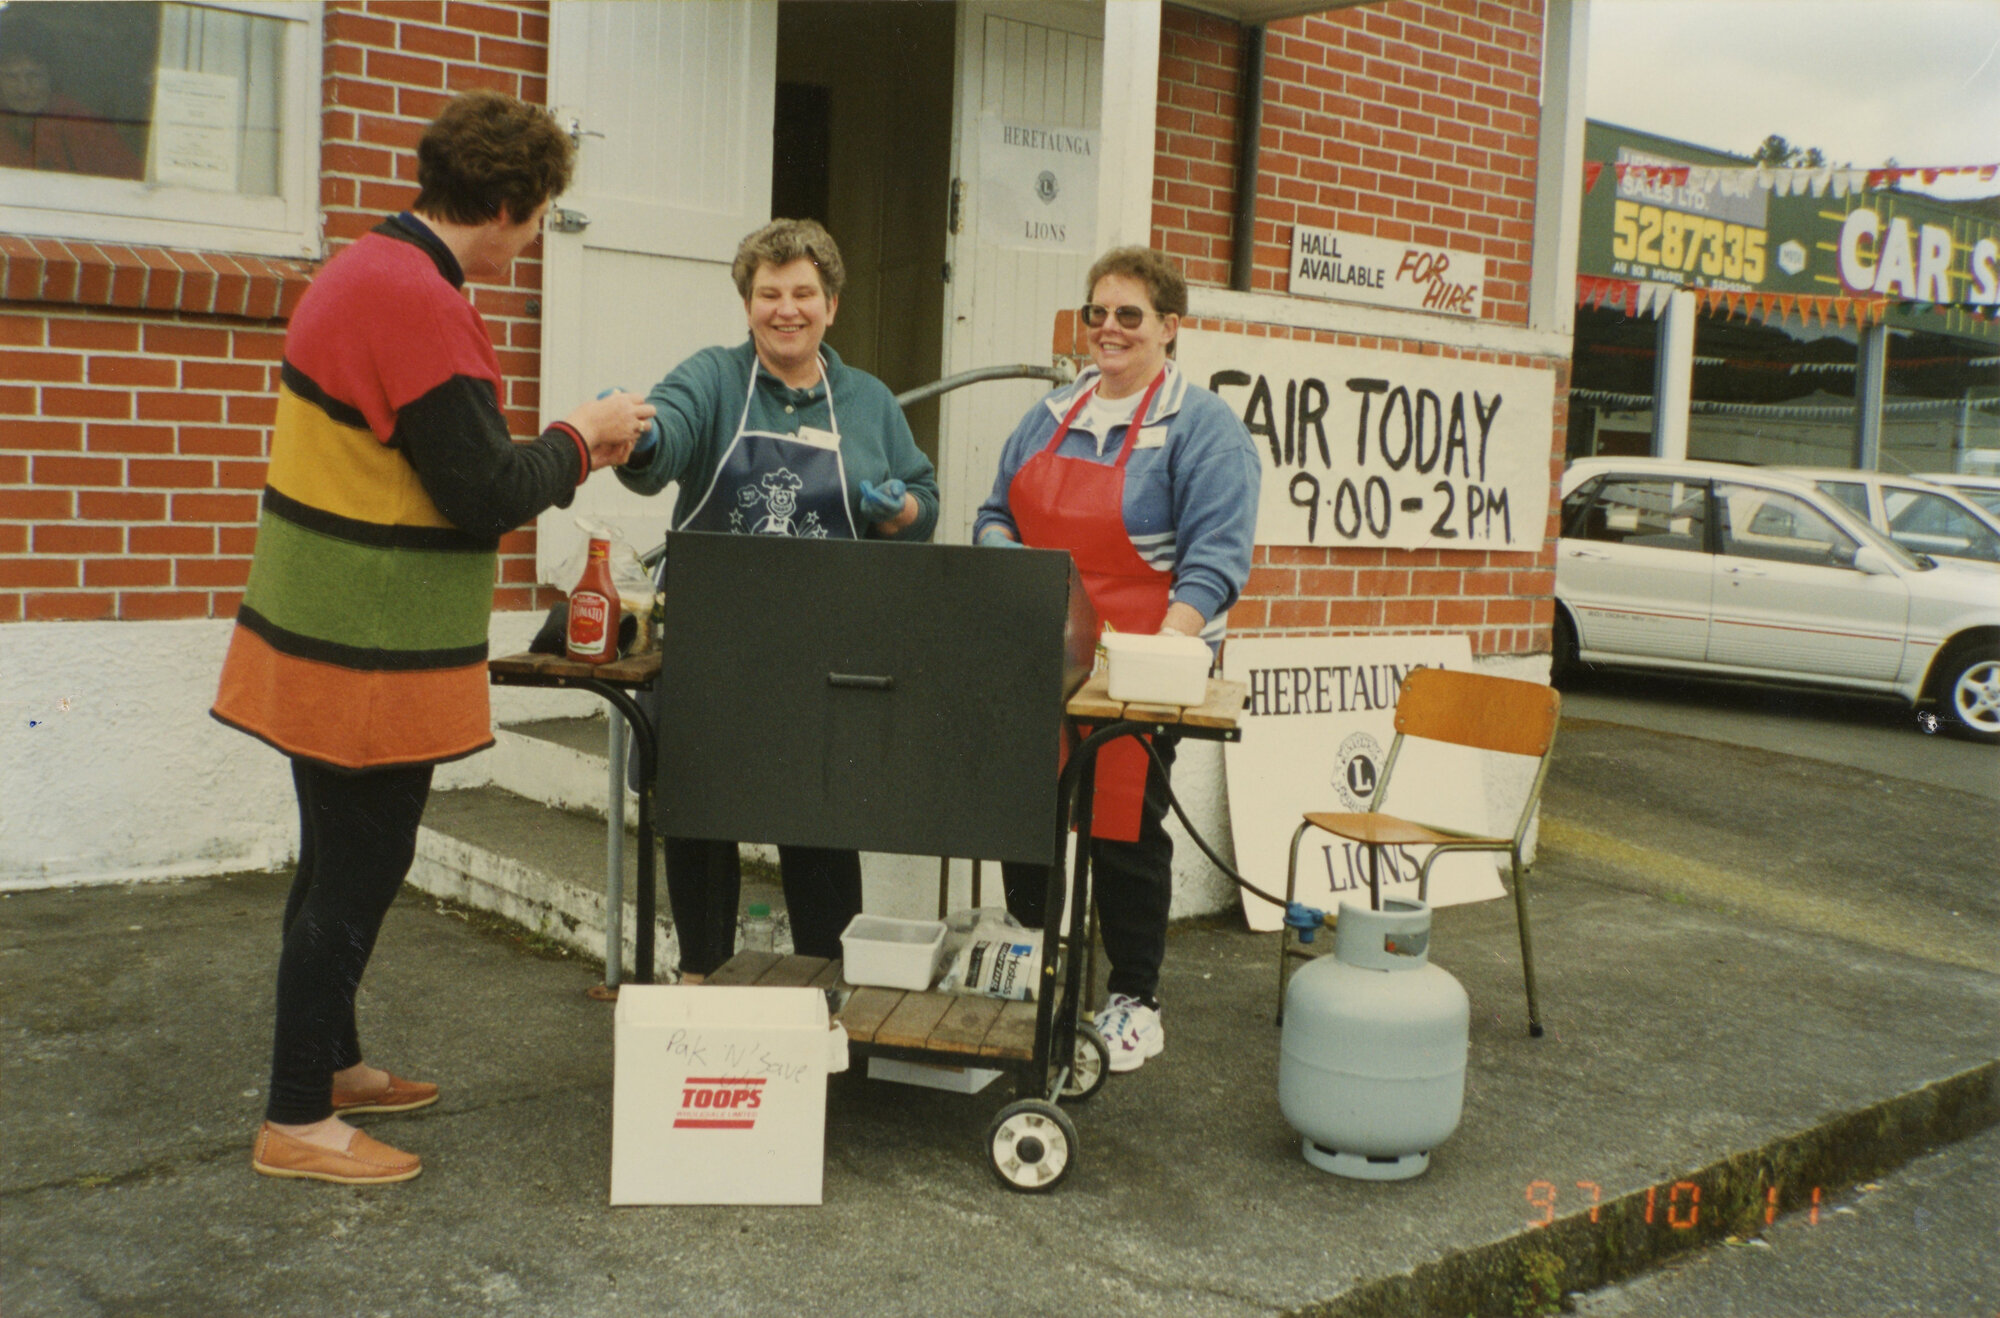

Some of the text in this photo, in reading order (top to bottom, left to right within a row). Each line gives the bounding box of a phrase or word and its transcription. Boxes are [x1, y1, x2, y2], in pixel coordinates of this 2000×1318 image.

[1003, 125, 1091, 156] HERETAUNGA
[1025, 220, 1066, 242] LIONS
[1300, 232, 1342, 259] HALL
[1612, 200, 1767, 284] 5287335
[1298, 257, 1385, 289] AVAILABLE
[1395, 249, 1450, 284] FOR
[1839, 207, 2000, 305] CAR S
[1422, 279, 1478, 314] HIRE
[1345, 377, 1502, 482] TODAY
[1249, 661, 1445, 717] HERETAUN
[666, 1028, 707, 1066] Pak
[682, 1088, 763, 1109] TOOPS
